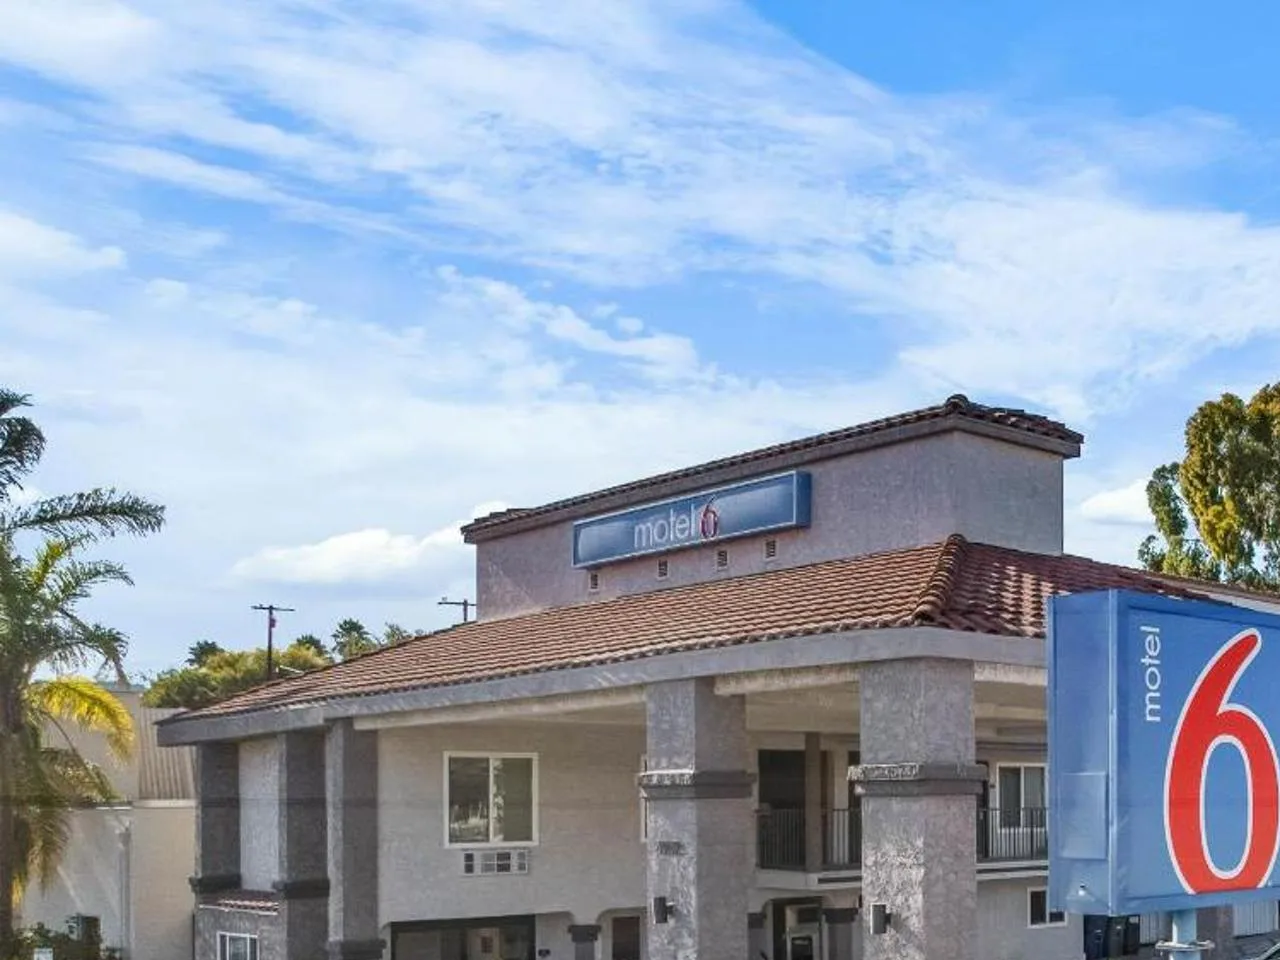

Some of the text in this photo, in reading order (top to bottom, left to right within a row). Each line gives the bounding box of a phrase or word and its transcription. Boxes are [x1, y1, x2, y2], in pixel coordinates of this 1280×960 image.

[634, 495, 719, 549] motel 6
[1140, 626, 1161, 722] motel
